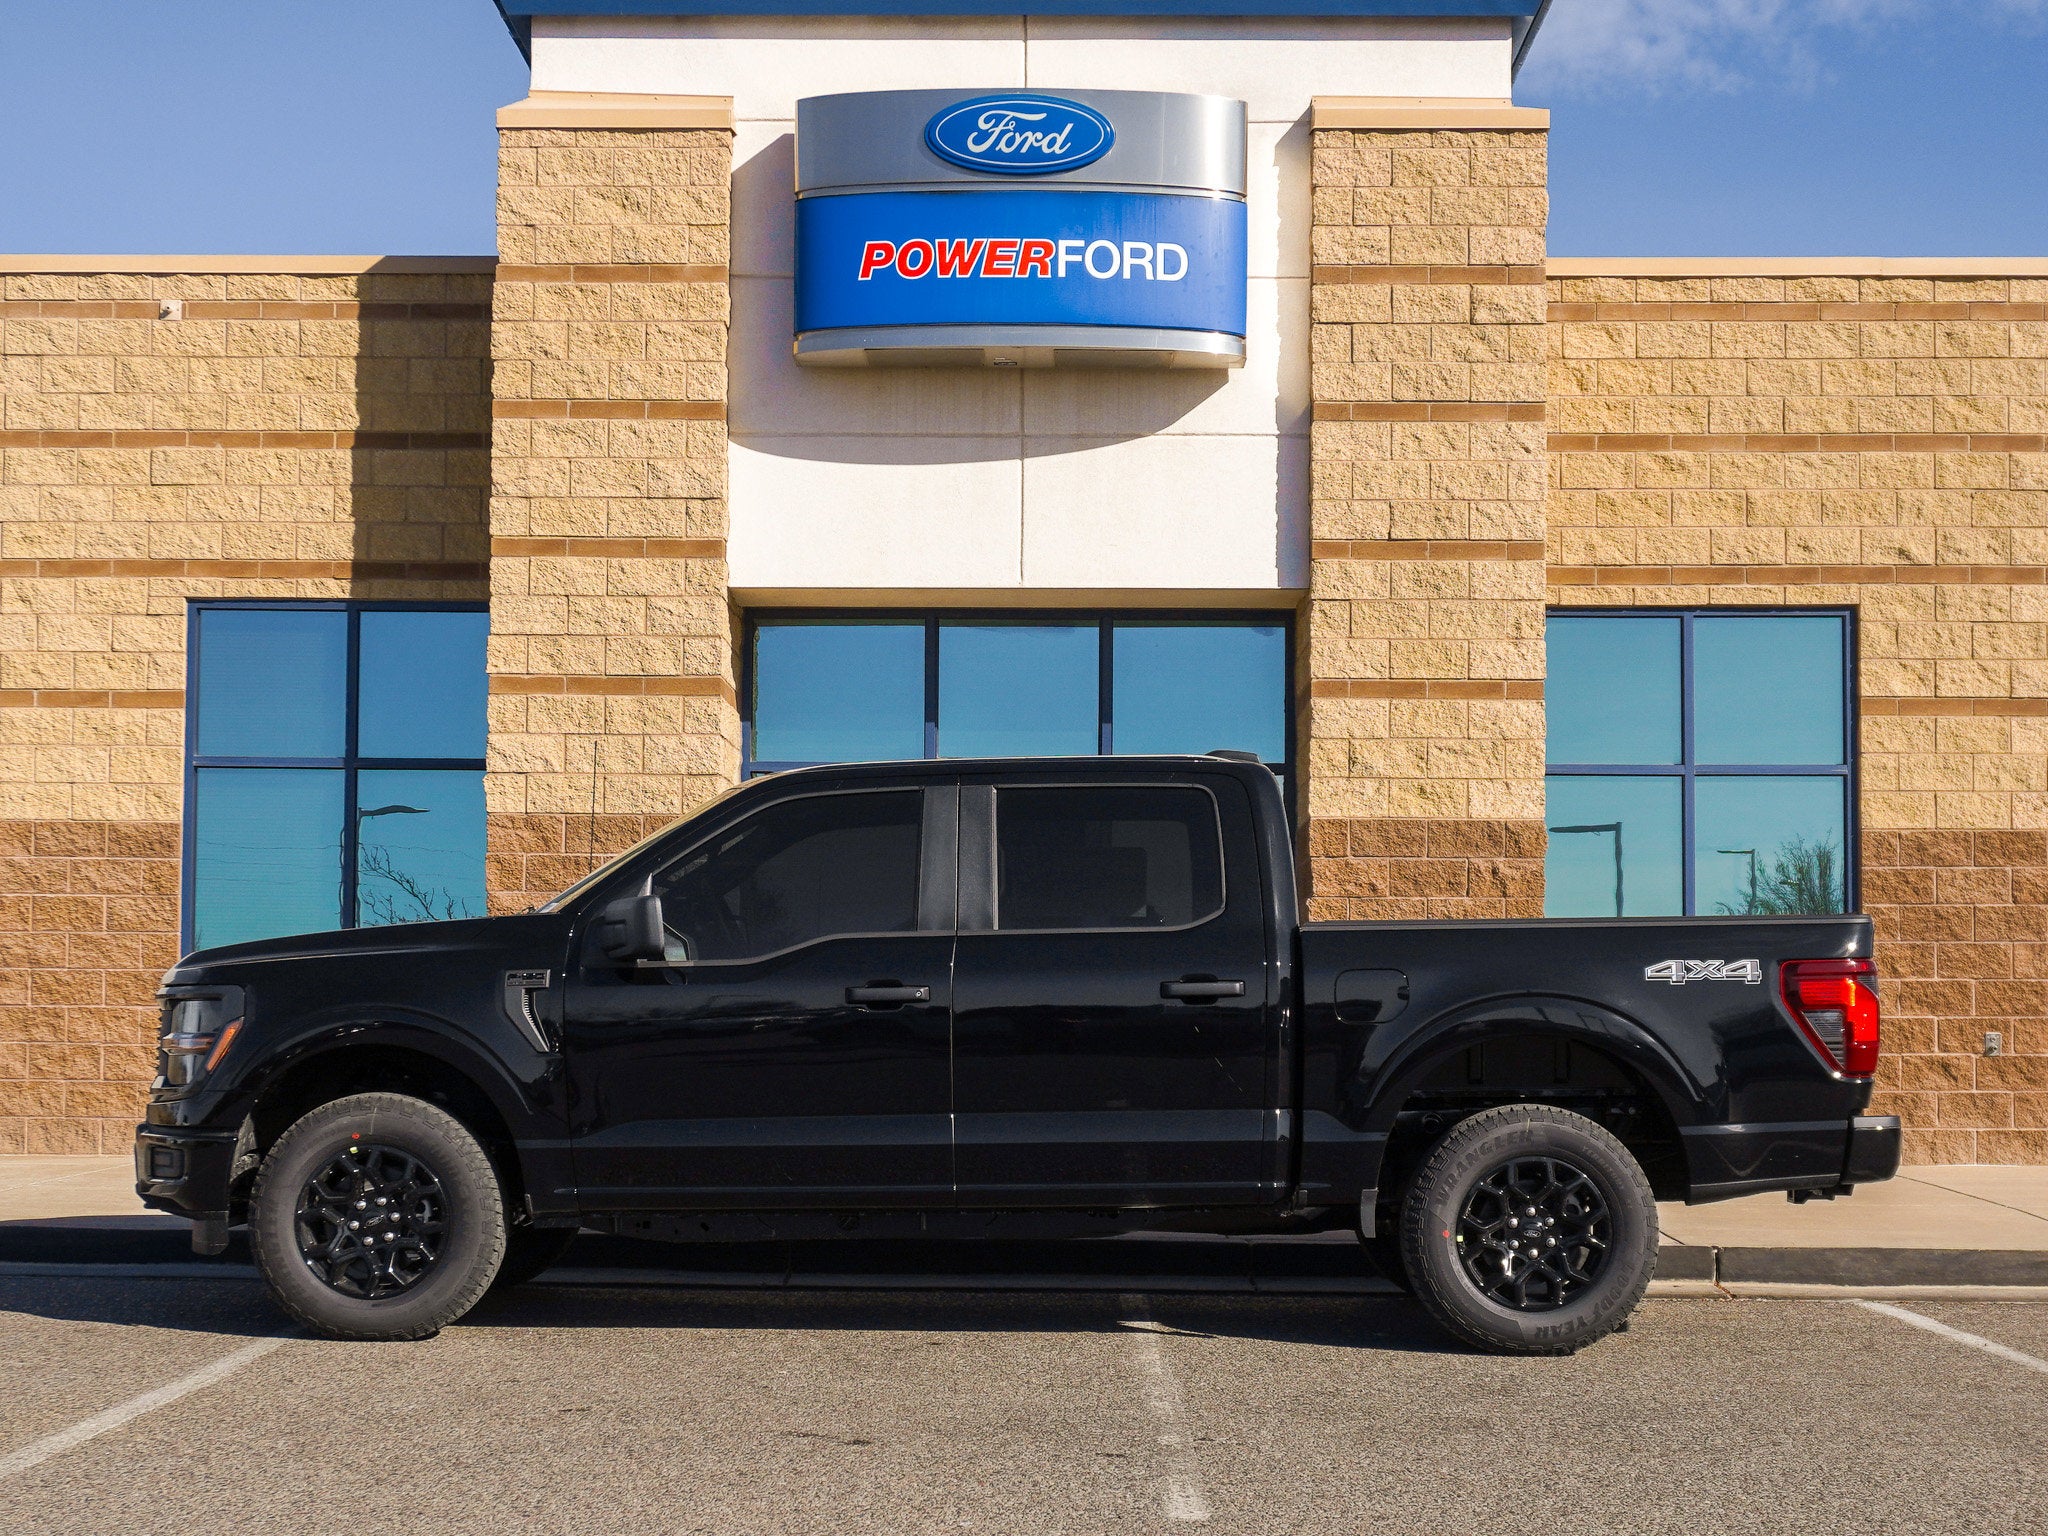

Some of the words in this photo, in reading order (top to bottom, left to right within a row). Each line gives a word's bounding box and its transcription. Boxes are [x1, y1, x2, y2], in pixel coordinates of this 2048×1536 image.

[967, 109, 1074, 155] Ford
[858, 239, 1189, 281] POWERFORD
[1434, 1129, 1535, 1209] WRANGLER
